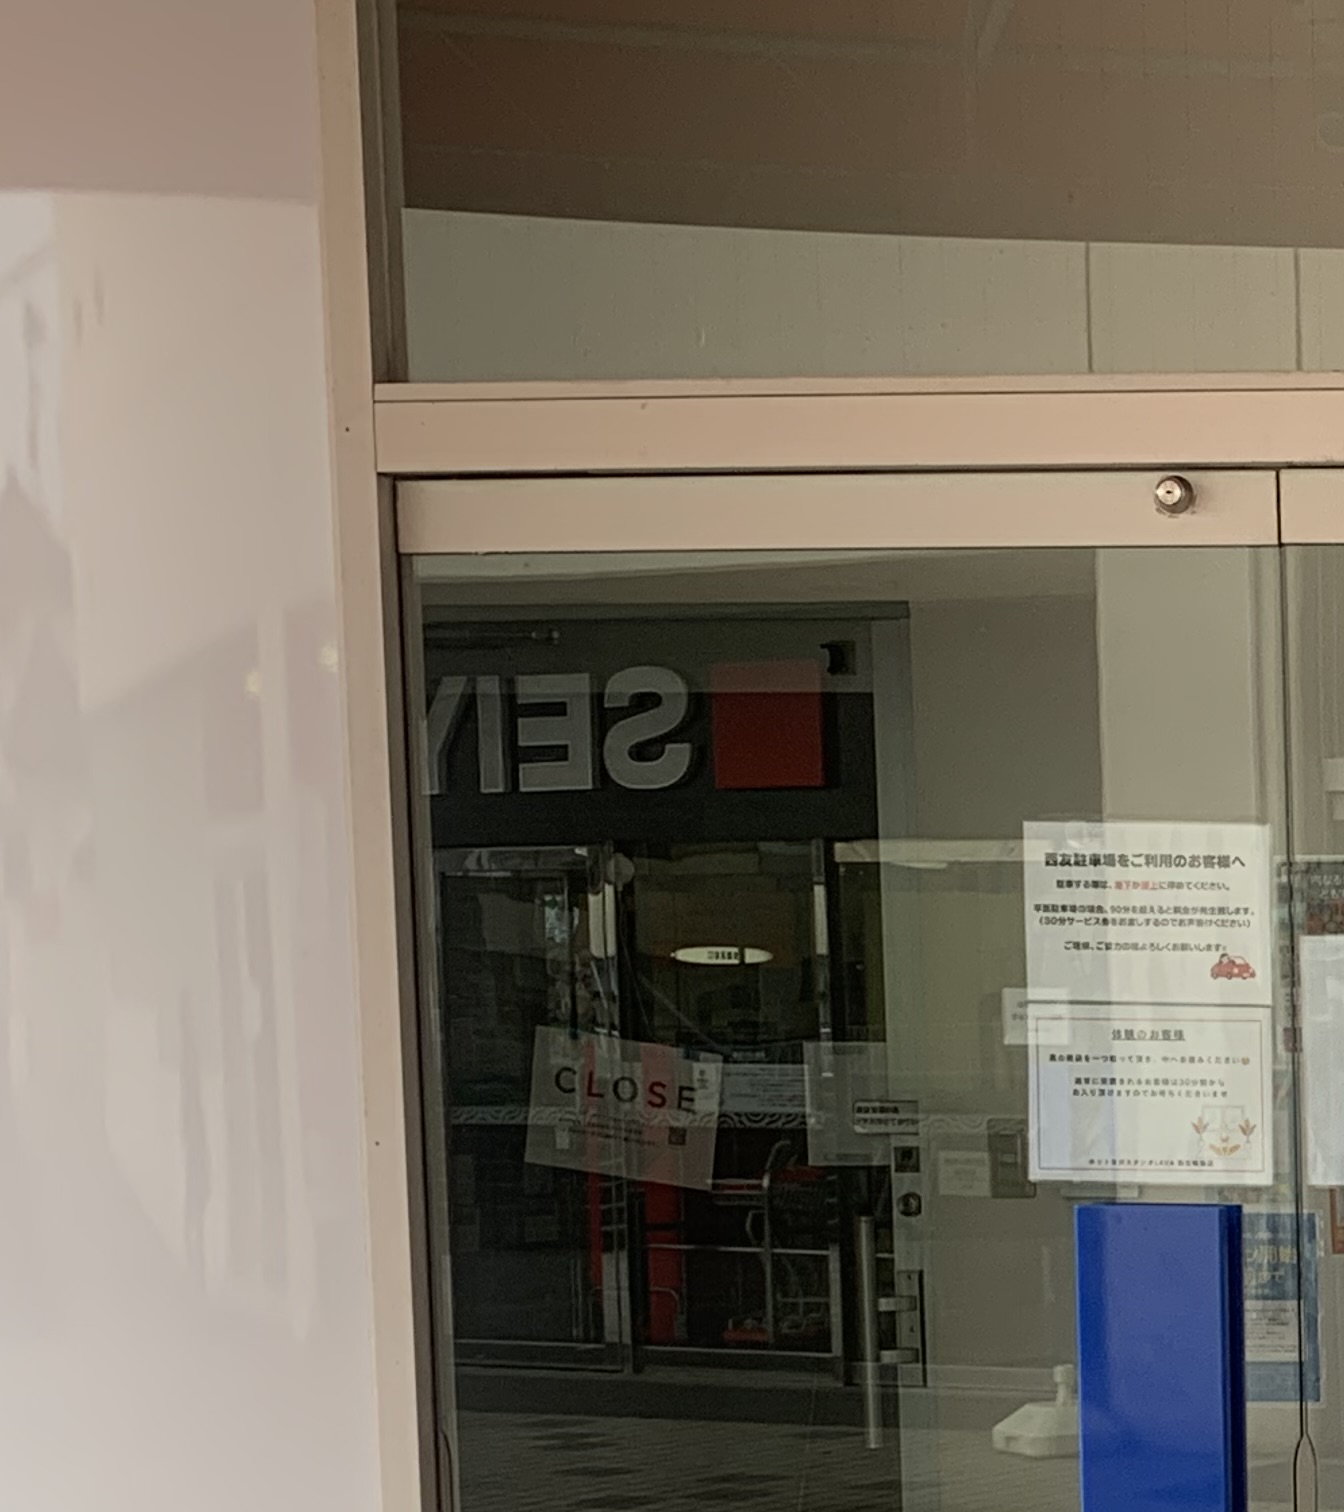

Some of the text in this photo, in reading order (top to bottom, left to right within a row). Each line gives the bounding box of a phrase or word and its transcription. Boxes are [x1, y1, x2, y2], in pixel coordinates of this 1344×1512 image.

[1044, 852, 1246, 869] 西友駐車場をご利用のお客様へ
[1111, 1028, 1187, 1042] 体験のお客様
[554, 1066, 698, 1116] CLOSE
